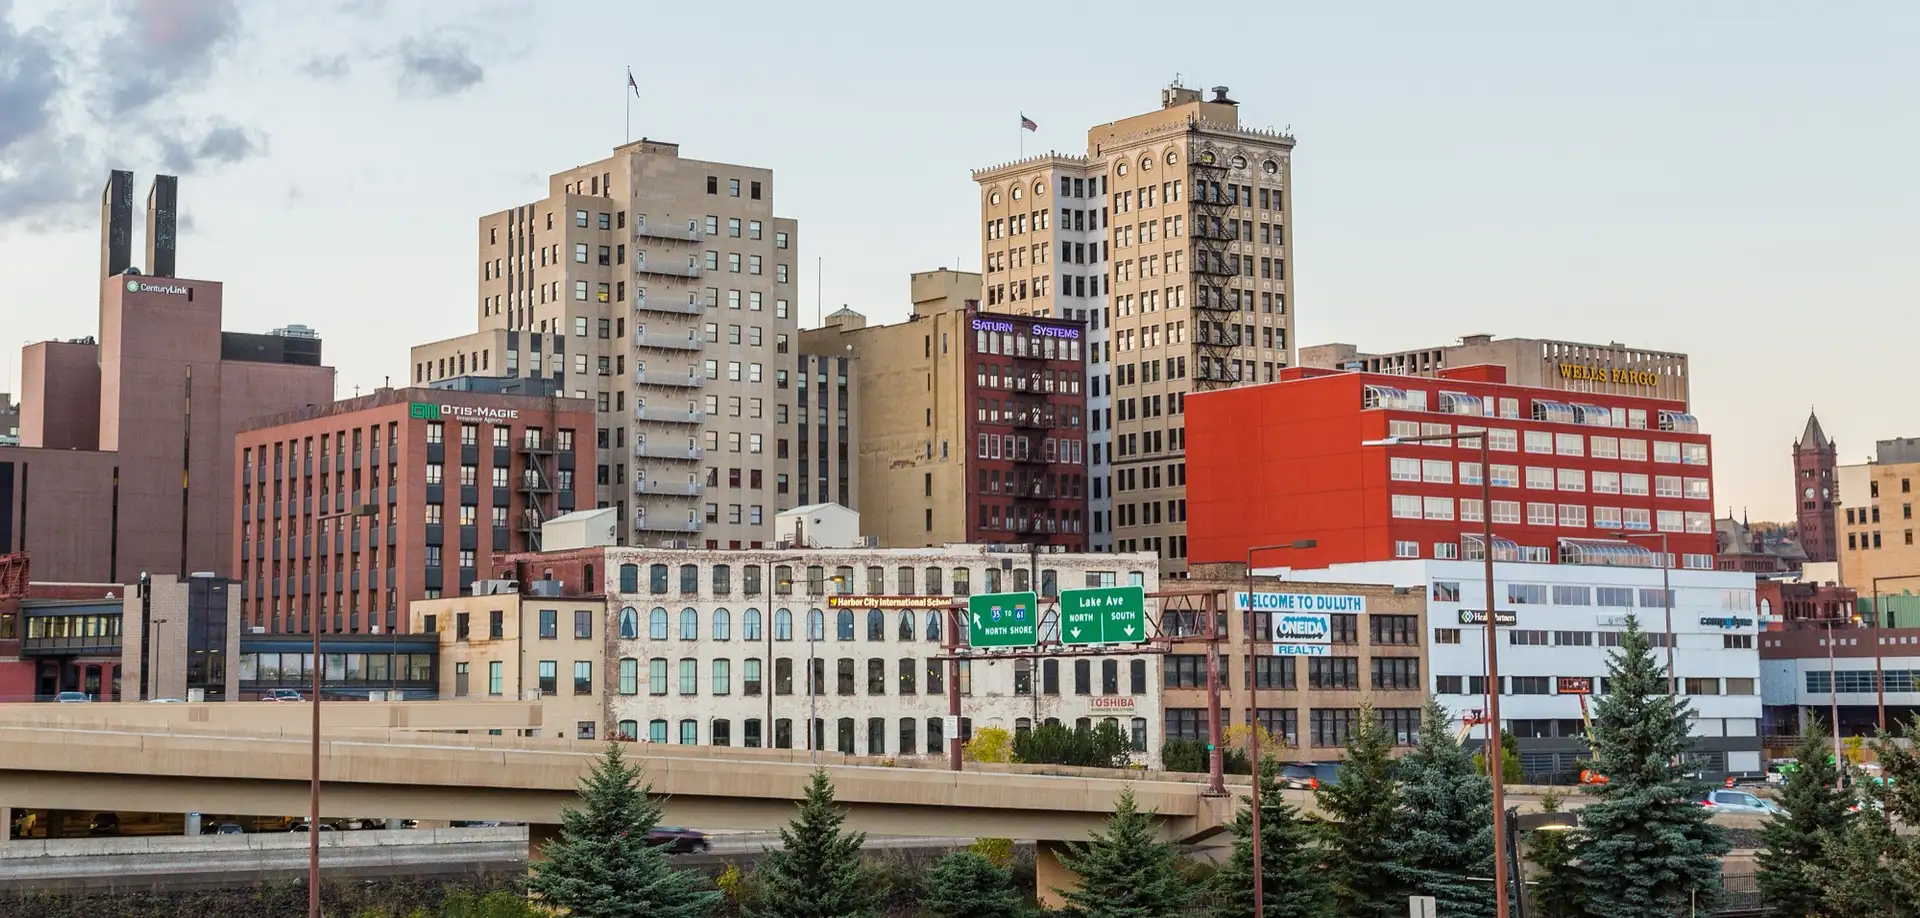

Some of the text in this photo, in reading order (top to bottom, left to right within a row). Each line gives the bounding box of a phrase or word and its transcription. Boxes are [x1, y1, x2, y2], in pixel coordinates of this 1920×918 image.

[141, 283, 188, 295] CenturyLink
[972, 319, 1079, 339] SATURN SYSTEMS
[1560, 363, 1658, 386] WELLS FARGO
[838, 597, 952, 608] Harbor City International School
[1080, 595, 1123, 608] Lake Ave
[1239, 594, 1361, 610] WELCOME TO DULUTH
[992, 610, 1001, 619] 35
[1016, 610, 1024, 619] 61
[1069, 613, 1093, 622] NORTH
[1111, 611, 1135, 620] SOUTH
[1474, 612, 1515, 622] Healartners
[985, 626, 1033, 635] NORTH SHORE
[1278, 617, 1327, 637] ONEIDA
[1278, 645, 1324, 655] REALTY
[1090, 698, 1135, 707] TOSHIBA
